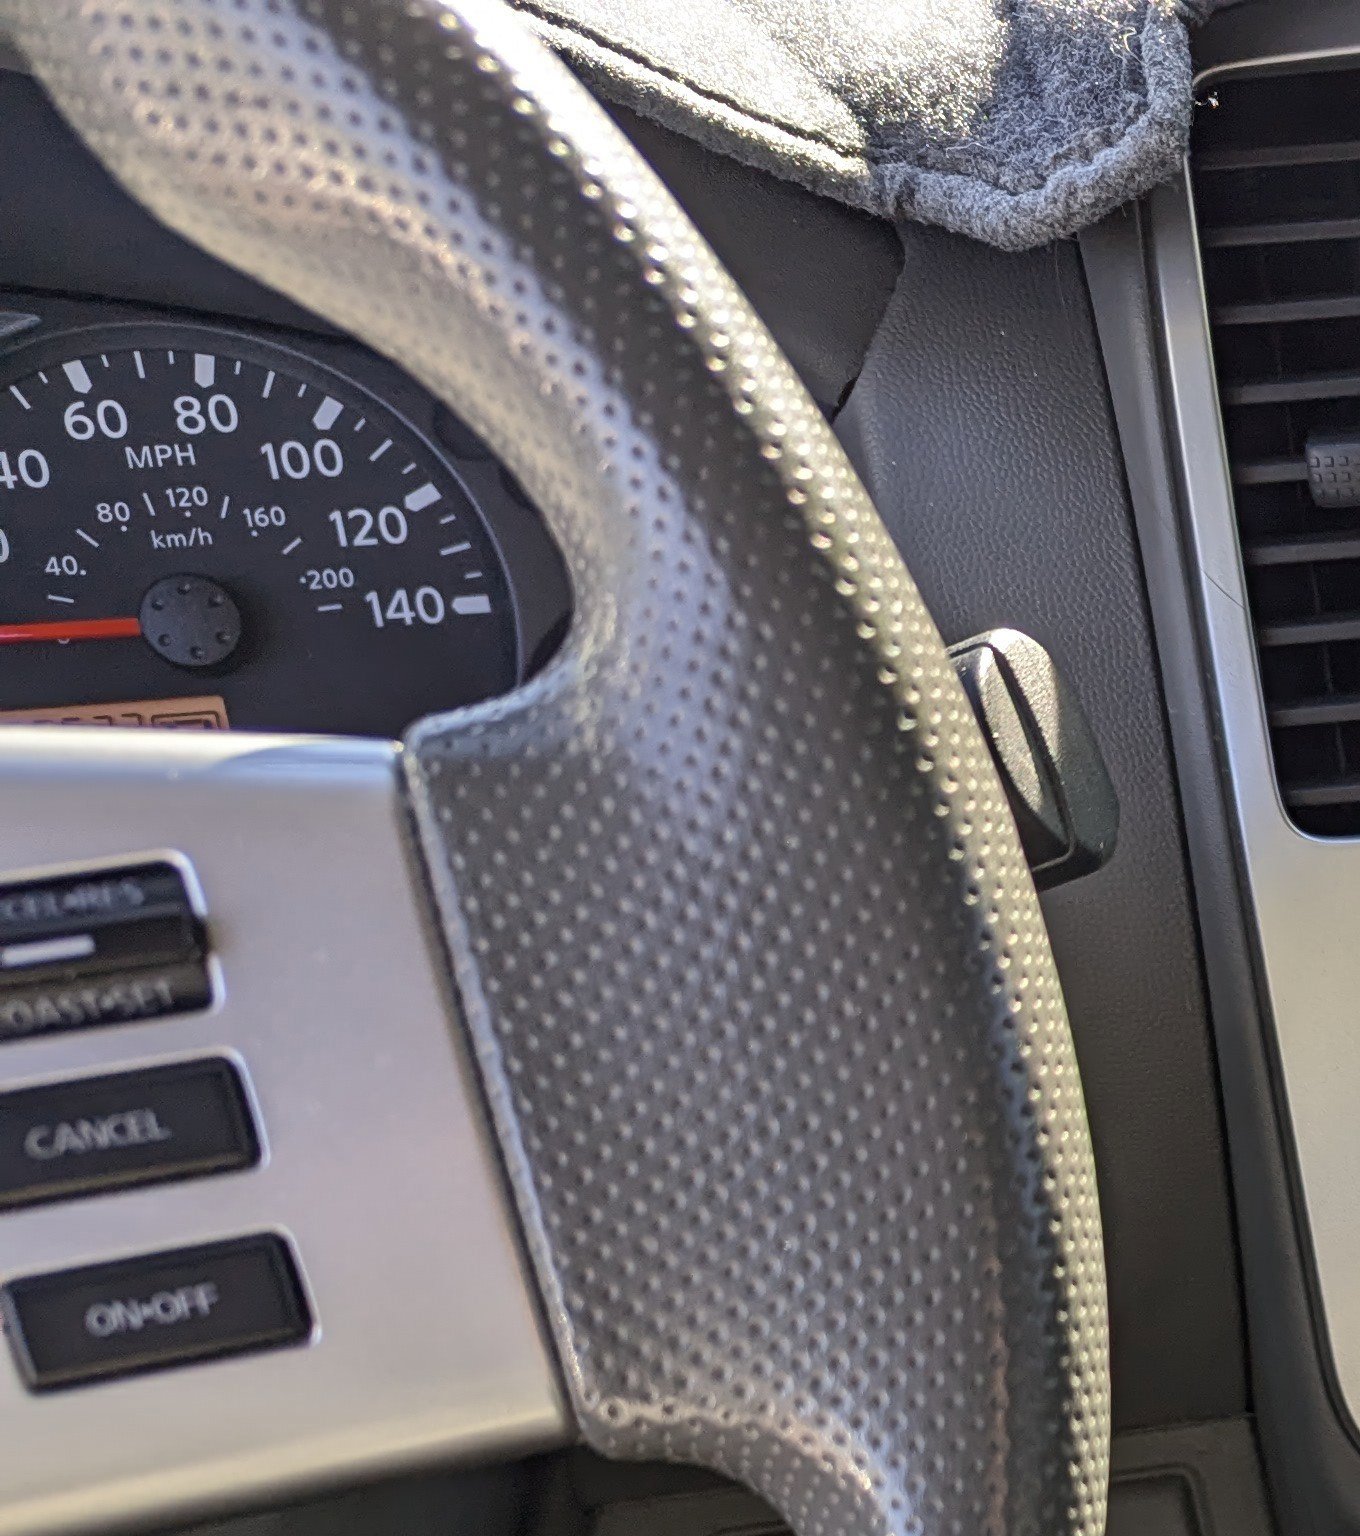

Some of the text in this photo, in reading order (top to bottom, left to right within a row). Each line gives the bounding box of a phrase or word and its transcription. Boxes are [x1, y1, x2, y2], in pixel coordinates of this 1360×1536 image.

[63, 399, 129, 441] 60
[173, 393, 239, 435] 80
[124, 443, 196, 469] MPH
[260, 438, 344, 480] 100
[96, 502, 131, 524] 80
[165, 486, 208, 509] 120
[243, 507, 286, 530] 160
[328, 506, 408, 548] 120
[150, 526, 214, 550] km/h
[305, 567, 355, 591] 200
[364, 585, 445, 628] 140
[24, 1107, 172, 1160] CANCEL
